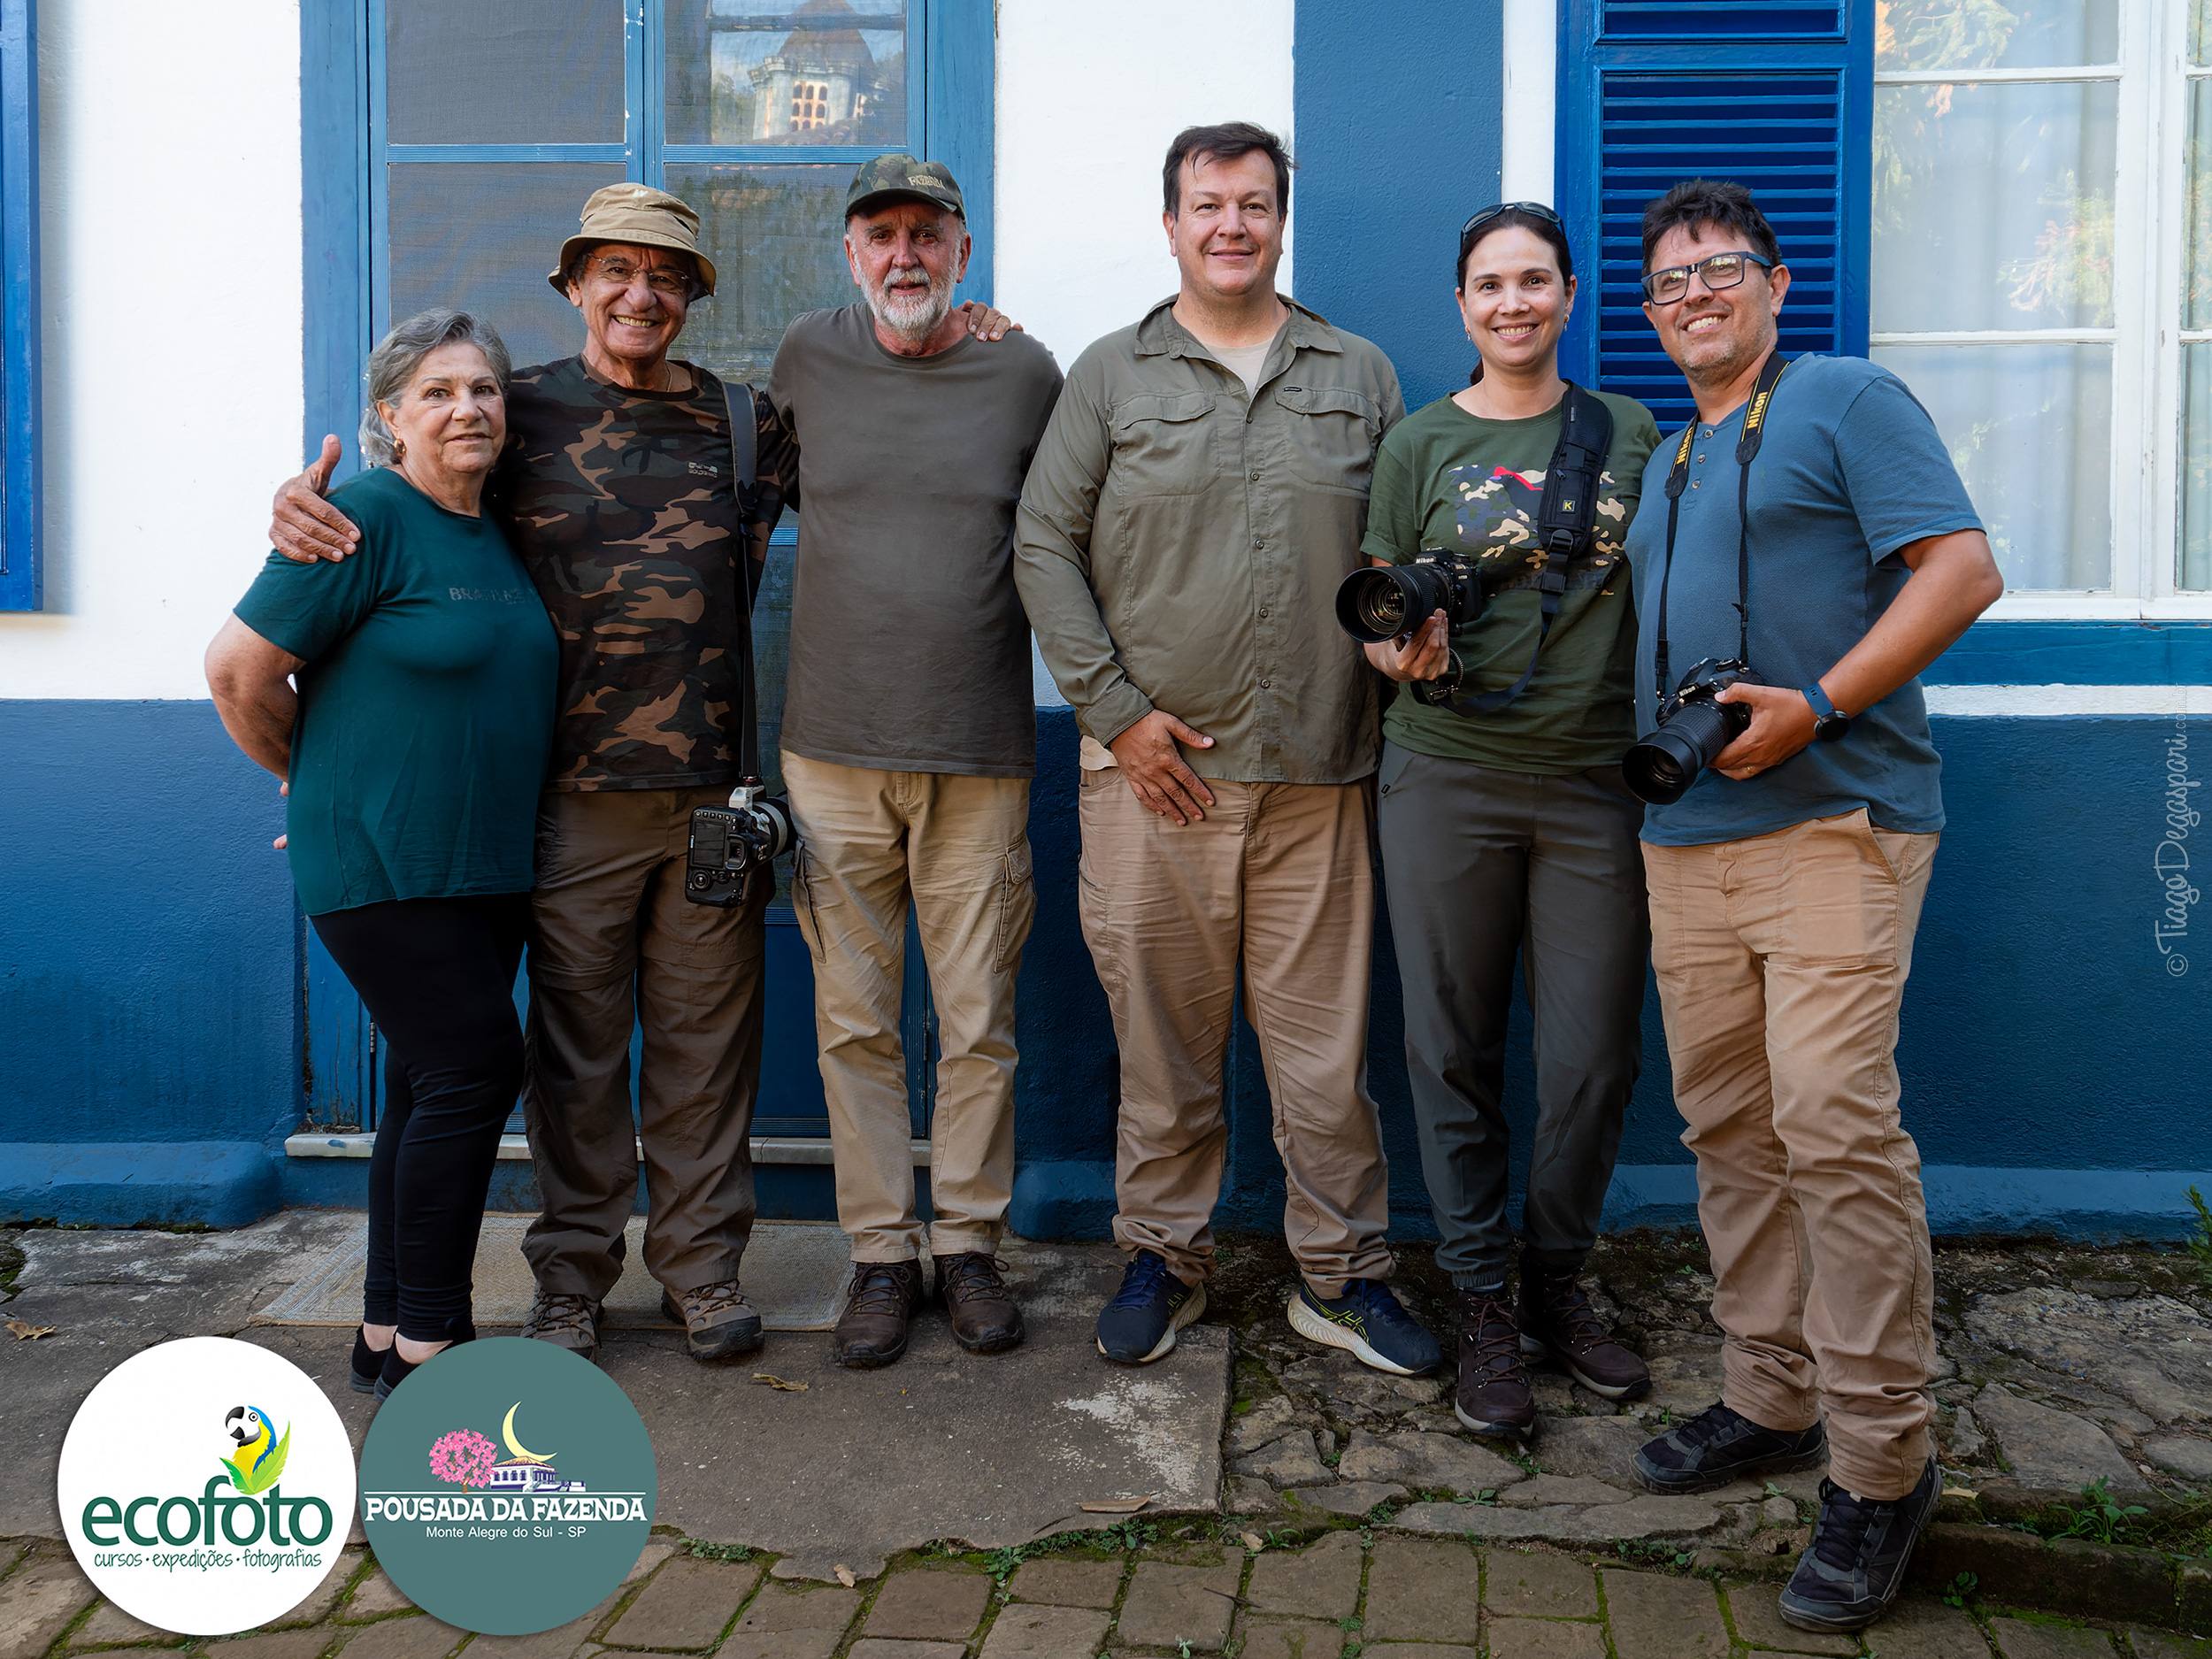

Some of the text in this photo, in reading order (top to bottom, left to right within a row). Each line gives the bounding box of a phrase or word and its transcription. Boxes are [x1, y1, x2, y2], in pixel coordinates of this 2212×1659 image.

[1747, 391, 1769, 429] Nikon
[1676, 426, 1694, 465] Nikon
[1563, 501, 1573, 511] K
[1678, 686, 1696, 696] Nikon
